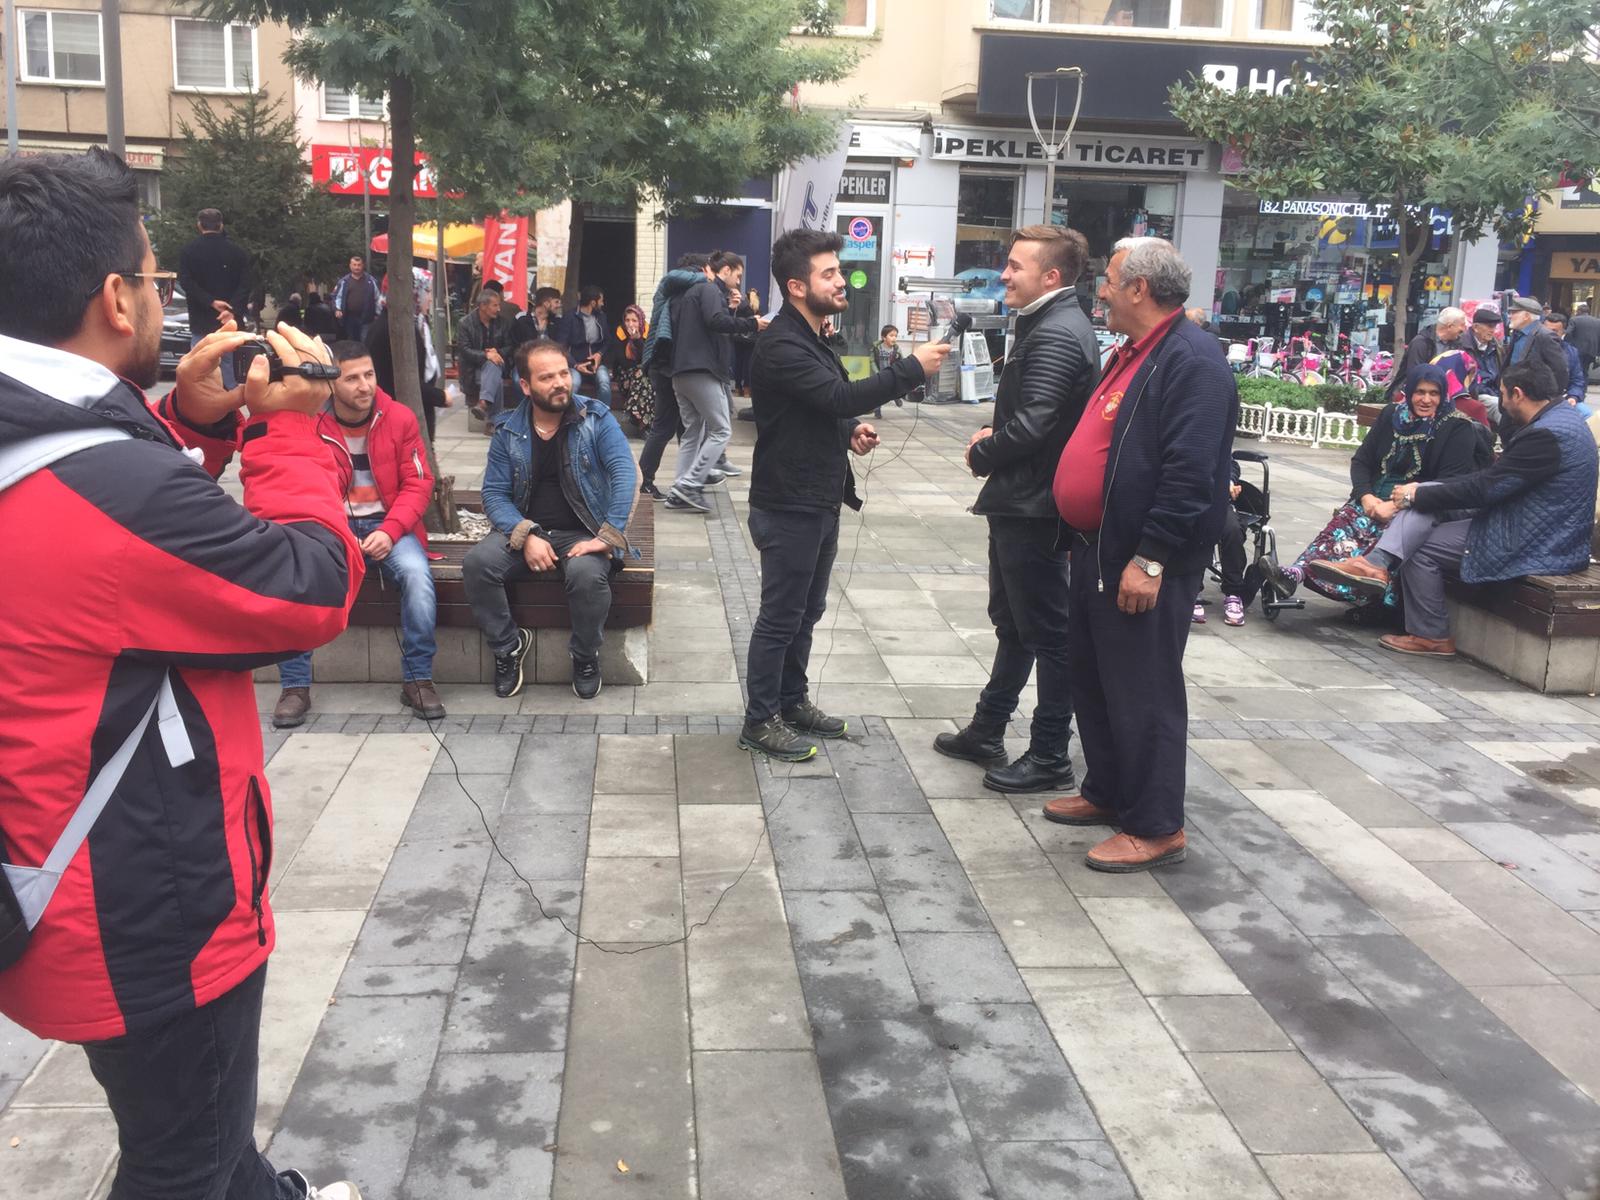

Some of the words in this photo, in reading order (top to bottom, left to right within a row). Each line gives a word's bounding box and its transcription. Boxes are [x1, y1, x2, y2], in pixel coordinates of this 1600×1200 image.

[1076, 140, 1205, 167] TİCARET
[840, 176, 887, 196] PEKLER
[494, 223, 518, 301] YAN
